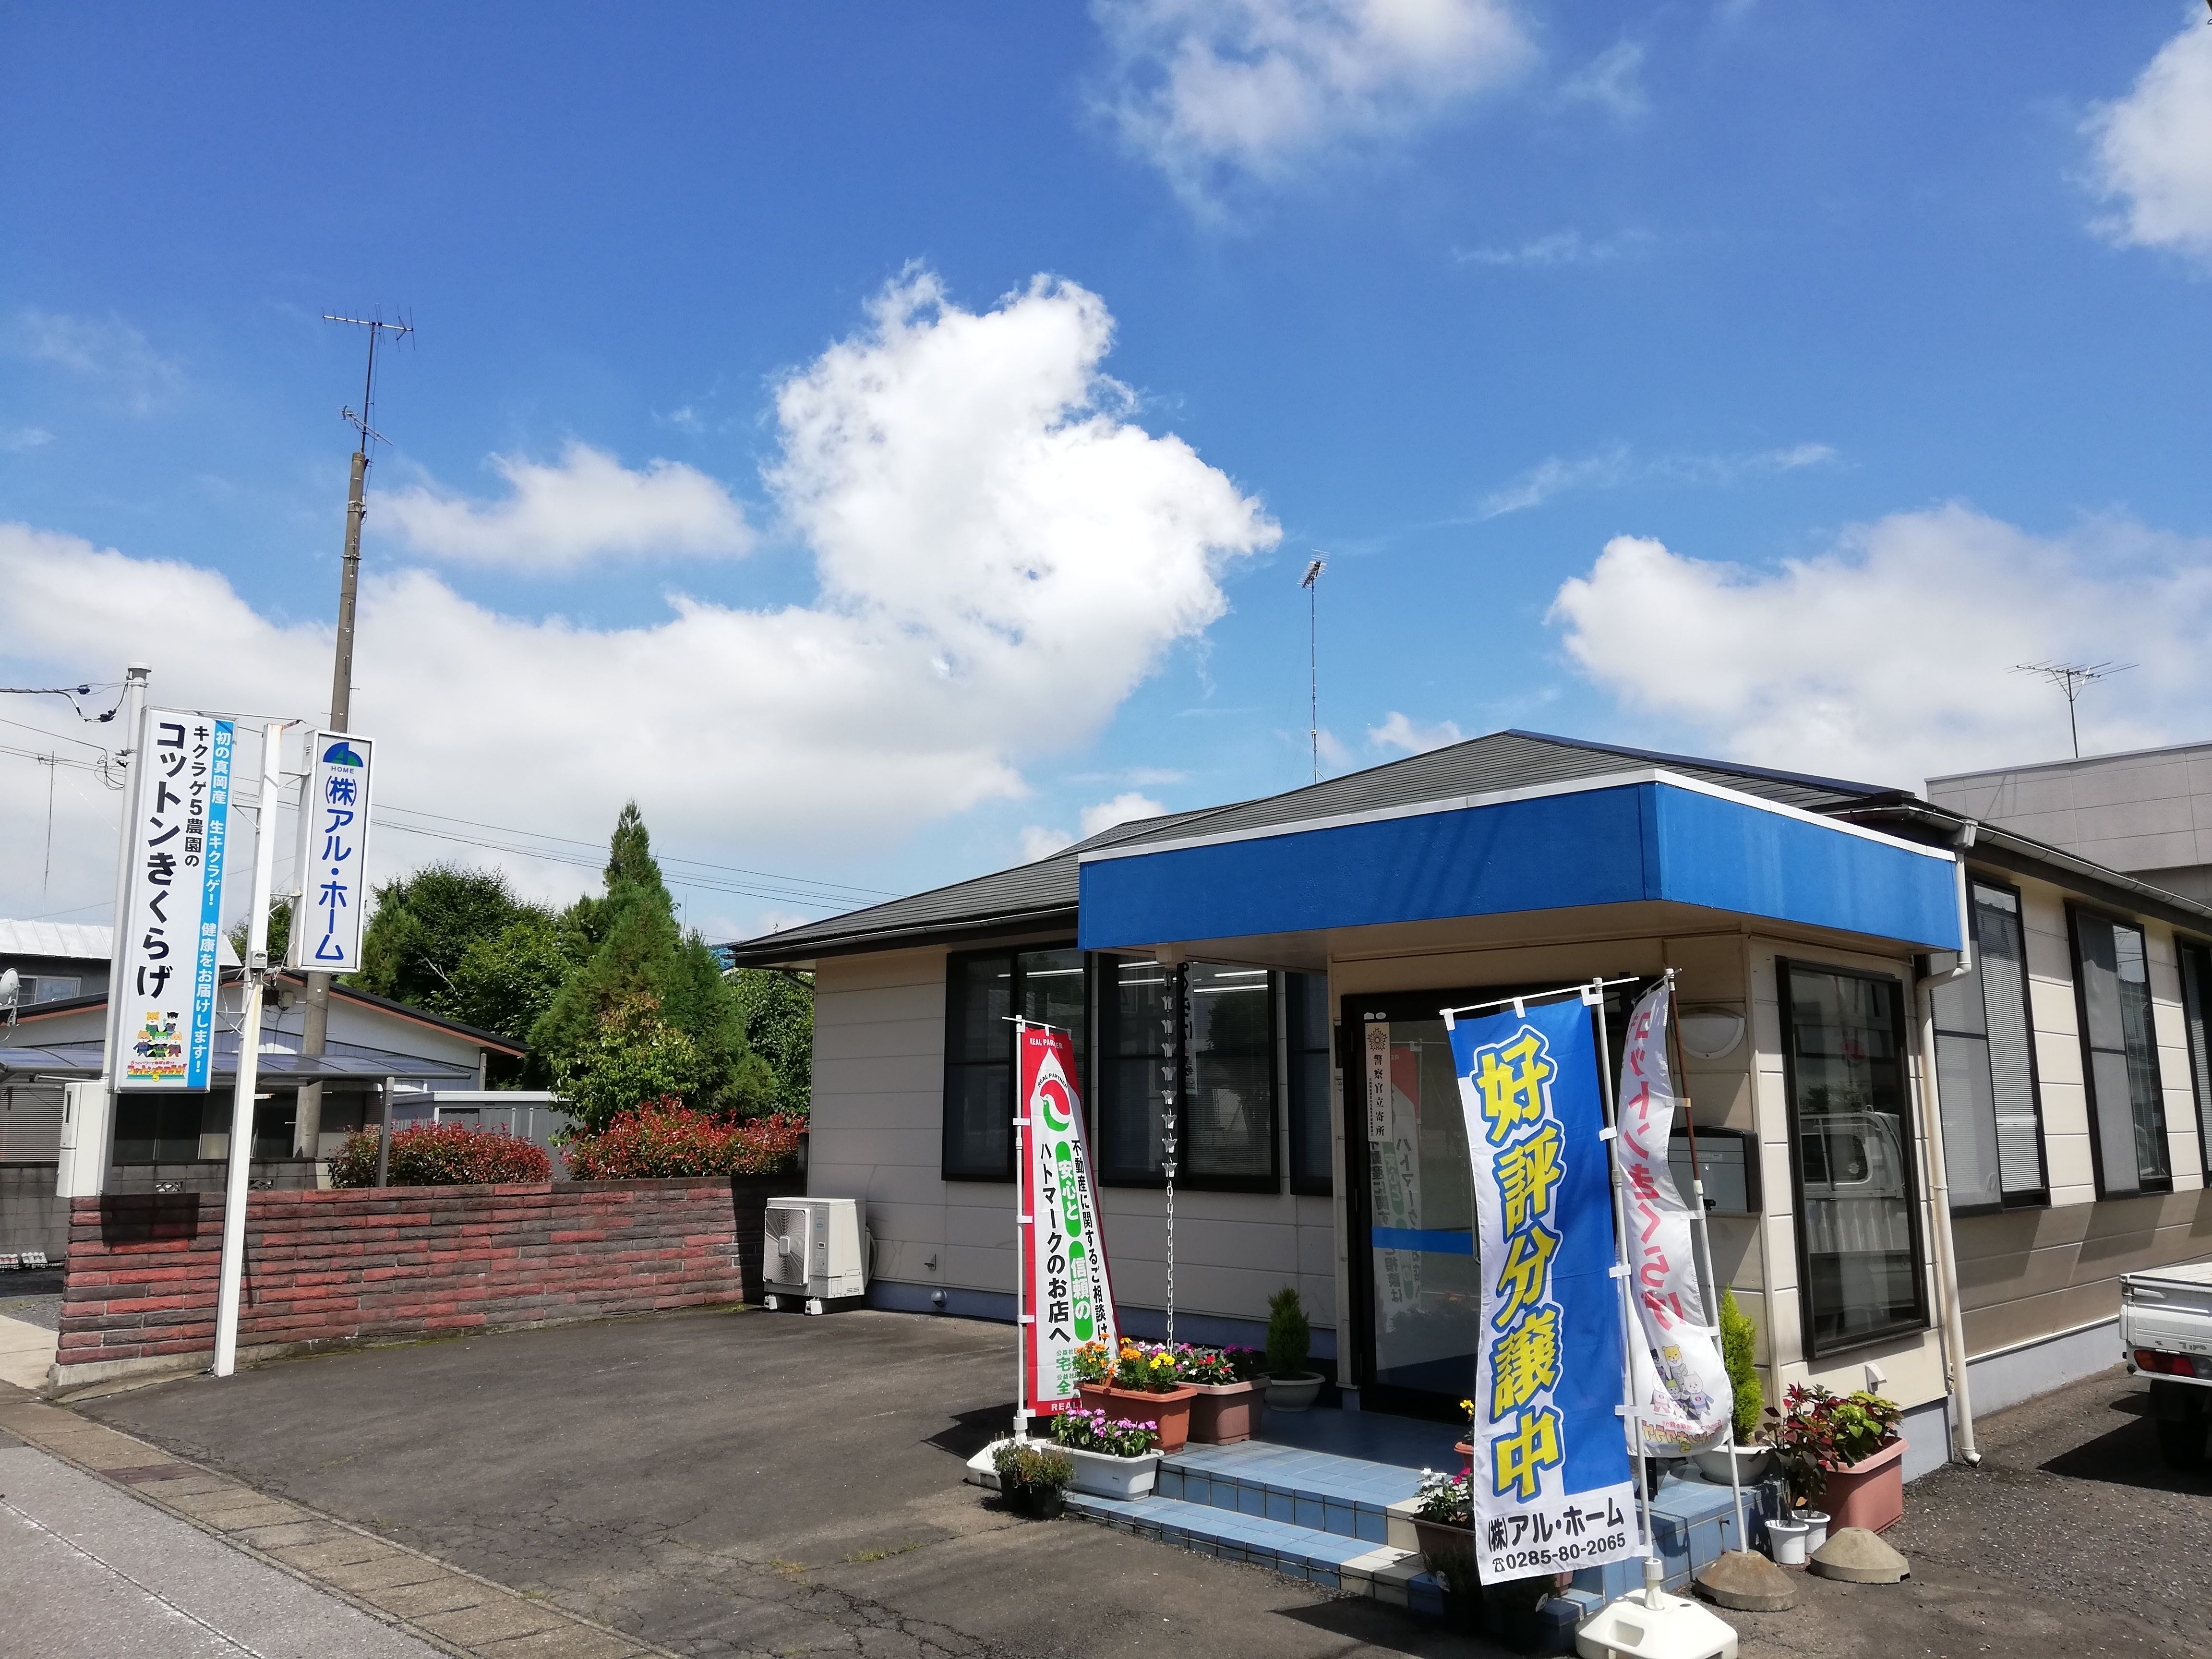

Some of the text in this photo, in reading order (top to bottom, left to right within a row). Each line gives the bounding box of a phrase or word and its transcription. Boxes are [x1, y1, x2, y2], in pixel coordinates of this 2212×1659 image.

[184, 725, 210, 868] キクラゲ5農園の
[211, 731, 231, 805] 初の真岡産
[136, 722, 187, 999] コットンきくらげ
[315, 775, 357, 961] (株)アル・ホーム
[193, 922, 217, 1073] 健康をお届けします!
[152, 1073, 160, 1082] 5
[1038, 1073, 1068, 1089] REAL PARTNER
[1373, 1054, 1384, 1136] 警察官立寄所
[1040, 1143, 1071, 1344] ハトマークのお店へ
[1058, 1160, 1090, 1321] 安心と 信頼の
[1475, 1032, 1563, 1498] 好評分譲中
[1488, 1497, 1624, 1552] (株)アル・ホーム
[1506, 1536, 1626, 1570] 0285-80-2065
